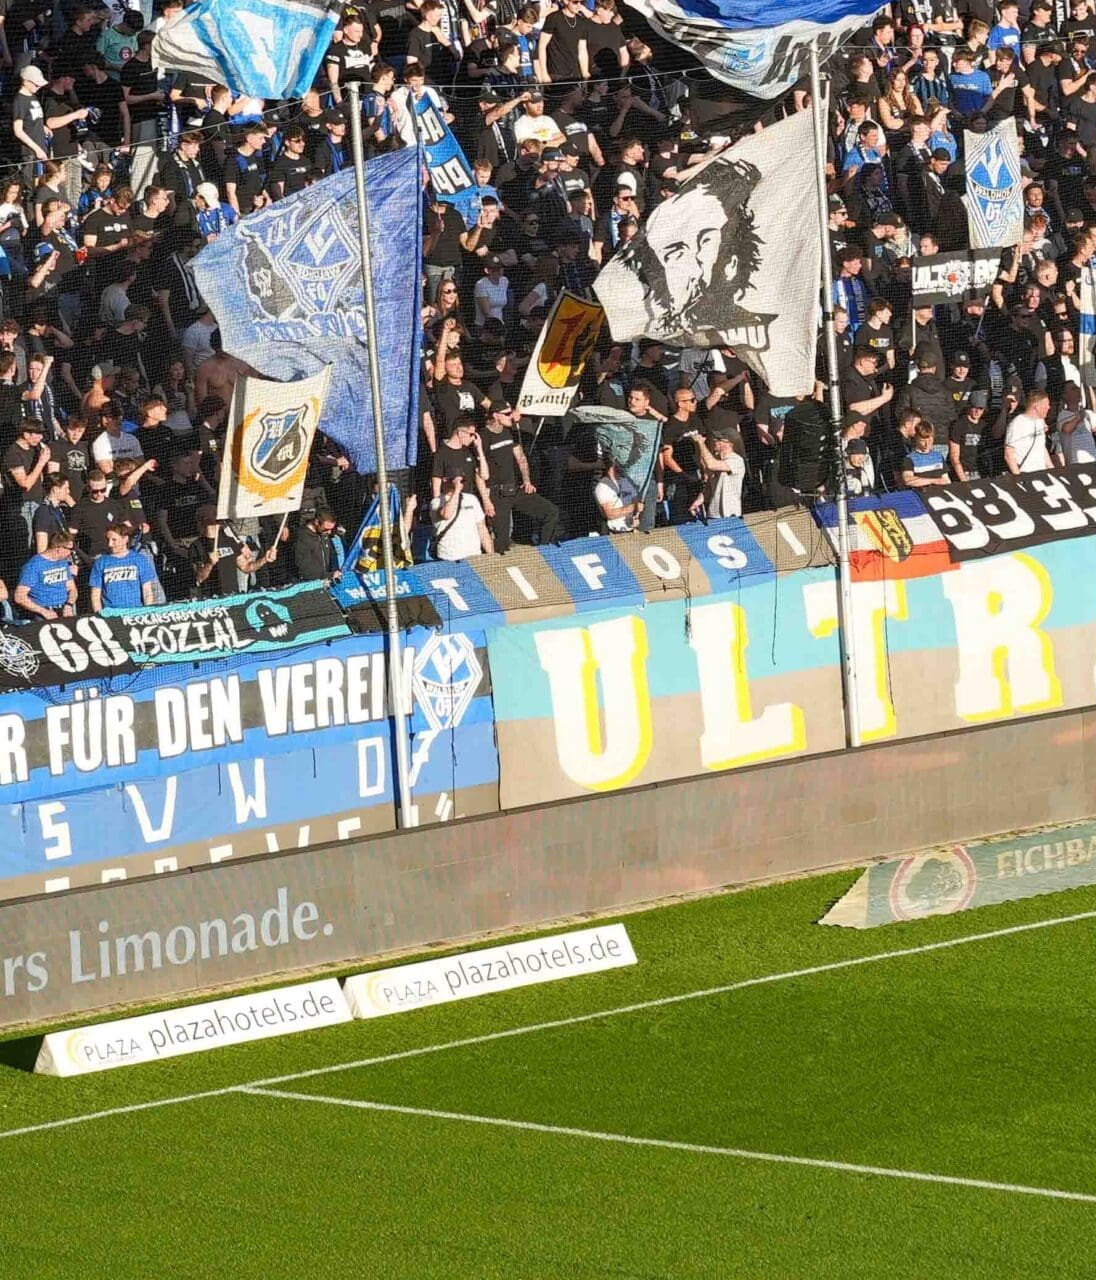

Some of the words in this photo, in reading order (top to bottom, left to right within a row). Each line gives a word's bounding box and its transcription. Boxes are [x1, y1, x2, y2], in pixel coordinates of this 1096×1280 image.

[431, 521, 807, 612] TIFOSI
[46, 687, 137, 777] FÜR
[155, 672, 243, 759] DEN
[69, 886, 335, 985] Limonade.
[383, 979, 440, 1003] PLAZA
[444, 933, 623, 997] plazahotels.de
[83, 1037, 143, 1062] PLAZA
[148, 989, 336, 1056] plazahotels.de
